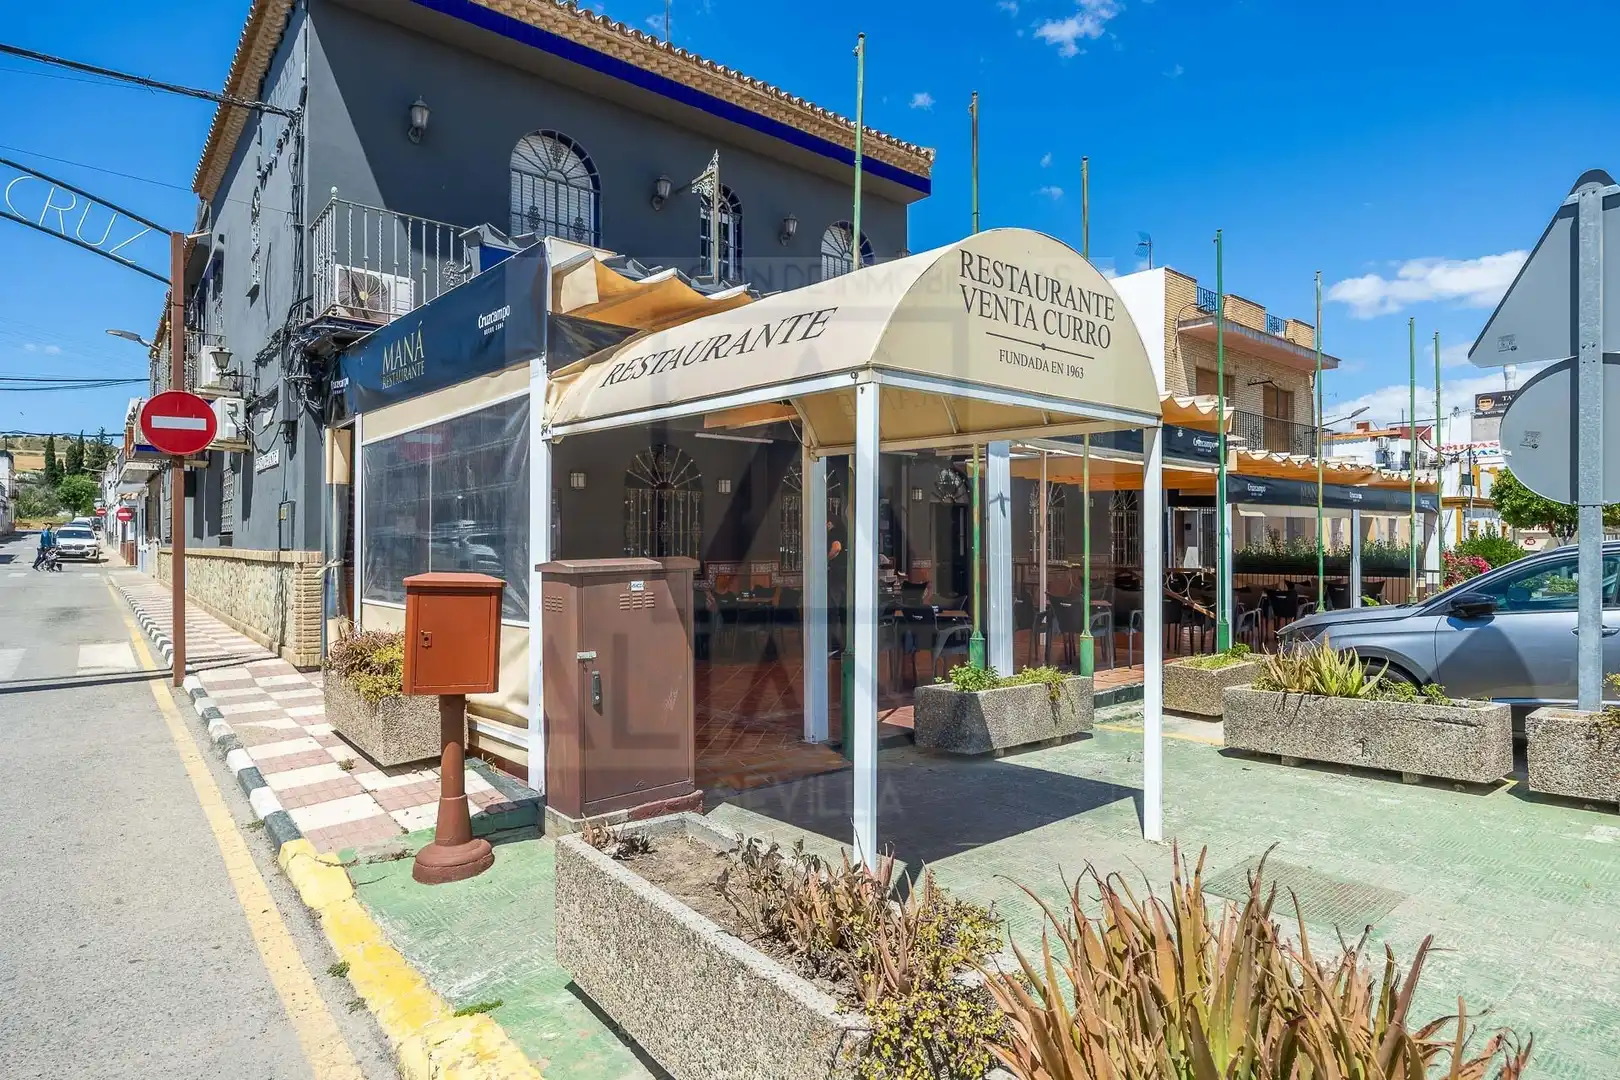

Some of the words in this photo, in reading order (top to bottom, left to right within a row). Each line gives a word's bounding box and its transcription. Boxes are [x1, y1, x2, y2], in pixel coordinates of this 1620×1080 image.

[5, 175, 152, 263] CRUZ
[959, 248, 1115, 322] RESTAURANTE
[478, 304, 511, 329] Cruzcampo
[959, 284, 1039, 332] VENTA
[1043, 308, 1111, 349] CURRO
[382, 360, 425, 390] RESTAURANTE
[383, 321, 425, 374] MANÁ
[599, 306, 839, 388] RESTAURANTE
[1000, 349, 1049, 373] FUNDADA
[1051, 361, 1064, 375] EN
[1066, 364, 1084, 379] 1963
